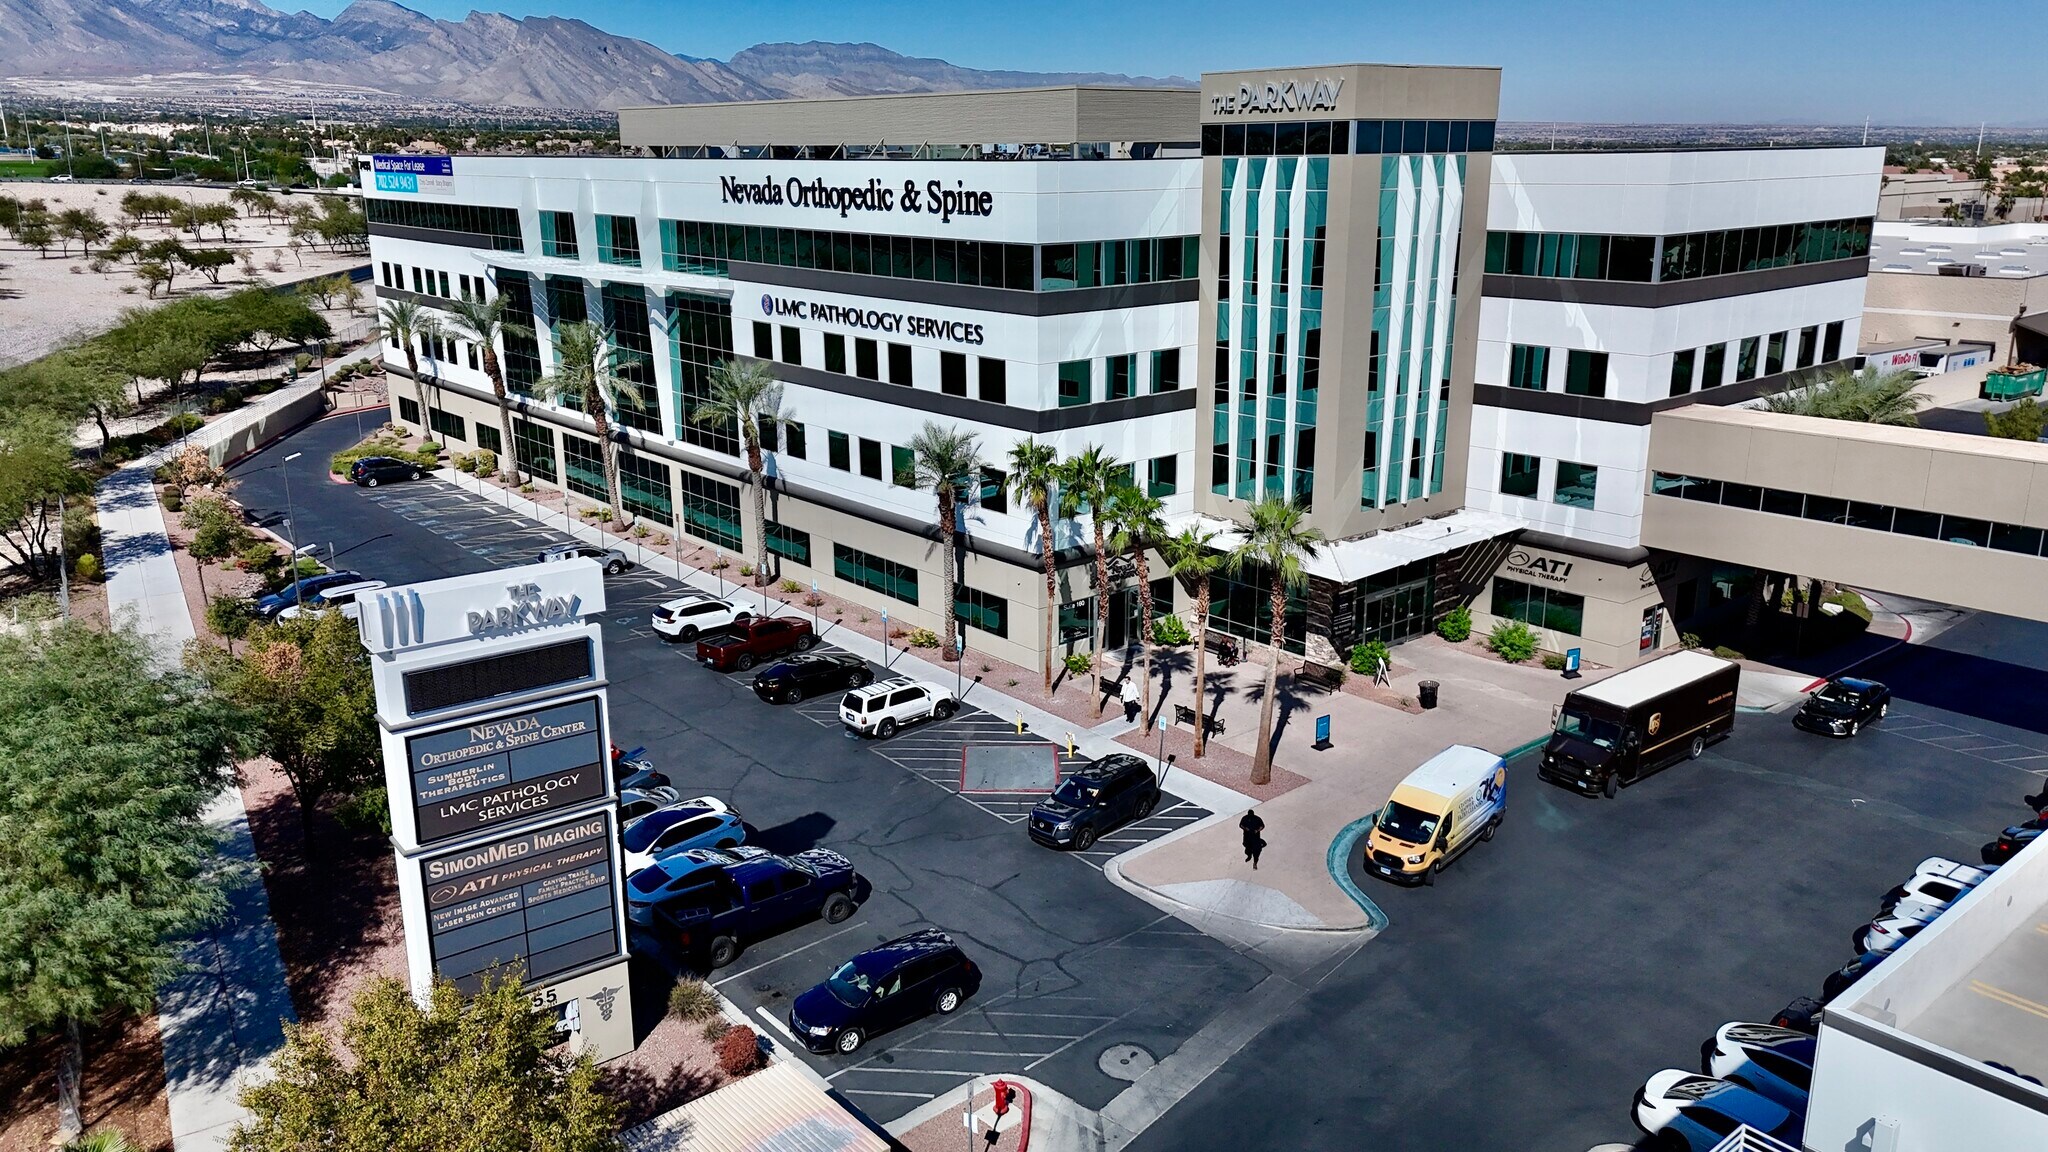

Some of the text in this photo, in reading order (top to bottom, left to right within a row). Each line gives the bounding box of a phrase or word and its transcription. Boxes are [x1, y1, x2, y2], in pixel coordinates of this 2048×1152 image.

[1212, 78, 1345, 114] THE PARKWAY
[375, 158, 391, 170] Medical
[391, 160, 404, 172] Space
[412, 160, 425, 172] Lease
[377, 174, 388, 188] 702
[388, 175, 399, 189] 524
[400, 176, 414, 190] 9431
[720, 176, 993, 223] Nevada Orthopedic & Spine
[775, 298, 984, 346] LMC PATHOLOGY SERVICES
[1892, 353, 1912, 366] WinCo
[1506, 566, 1568, 584] PHYSICAL THERAPY
[1528, 557, 1574, 576] ATI
[506, 582, 541, 602] THE
[466, 593, 582, 634] PARKWAY
[420, 720, 586, 766] ORTHOPEDIC & SPINE CENTER
[468, 716, 541, 743] NEVADA
[420, 773, 506, 799] THERAPEUTICS
[428, 762, 495, 784] SUMMERLIN
[448, 773, 478, 786] BODY
[440, 773, 580, 819] LMC PATHOLOGY
[478, 794, 549, 822] SERVICES
[429, 820, 603, 879] SIMONMED IMAGING
[458, 846, 604, 896] ATI PHYSICAL THERAPY
[542, 869, 590, 886] CANYON TRAILS
[528, 892, 552, 904] SPORTS
[585, 875, 606, 886] MDVIP
[538, 884, 559, 895] FAMILY
[560, 876, 588, 888] PRACTICE
[434, 892, 519, 922] NEW IMAGE ADVANCED
[438, 902, 517, 930] LASER SKIN CENTER
